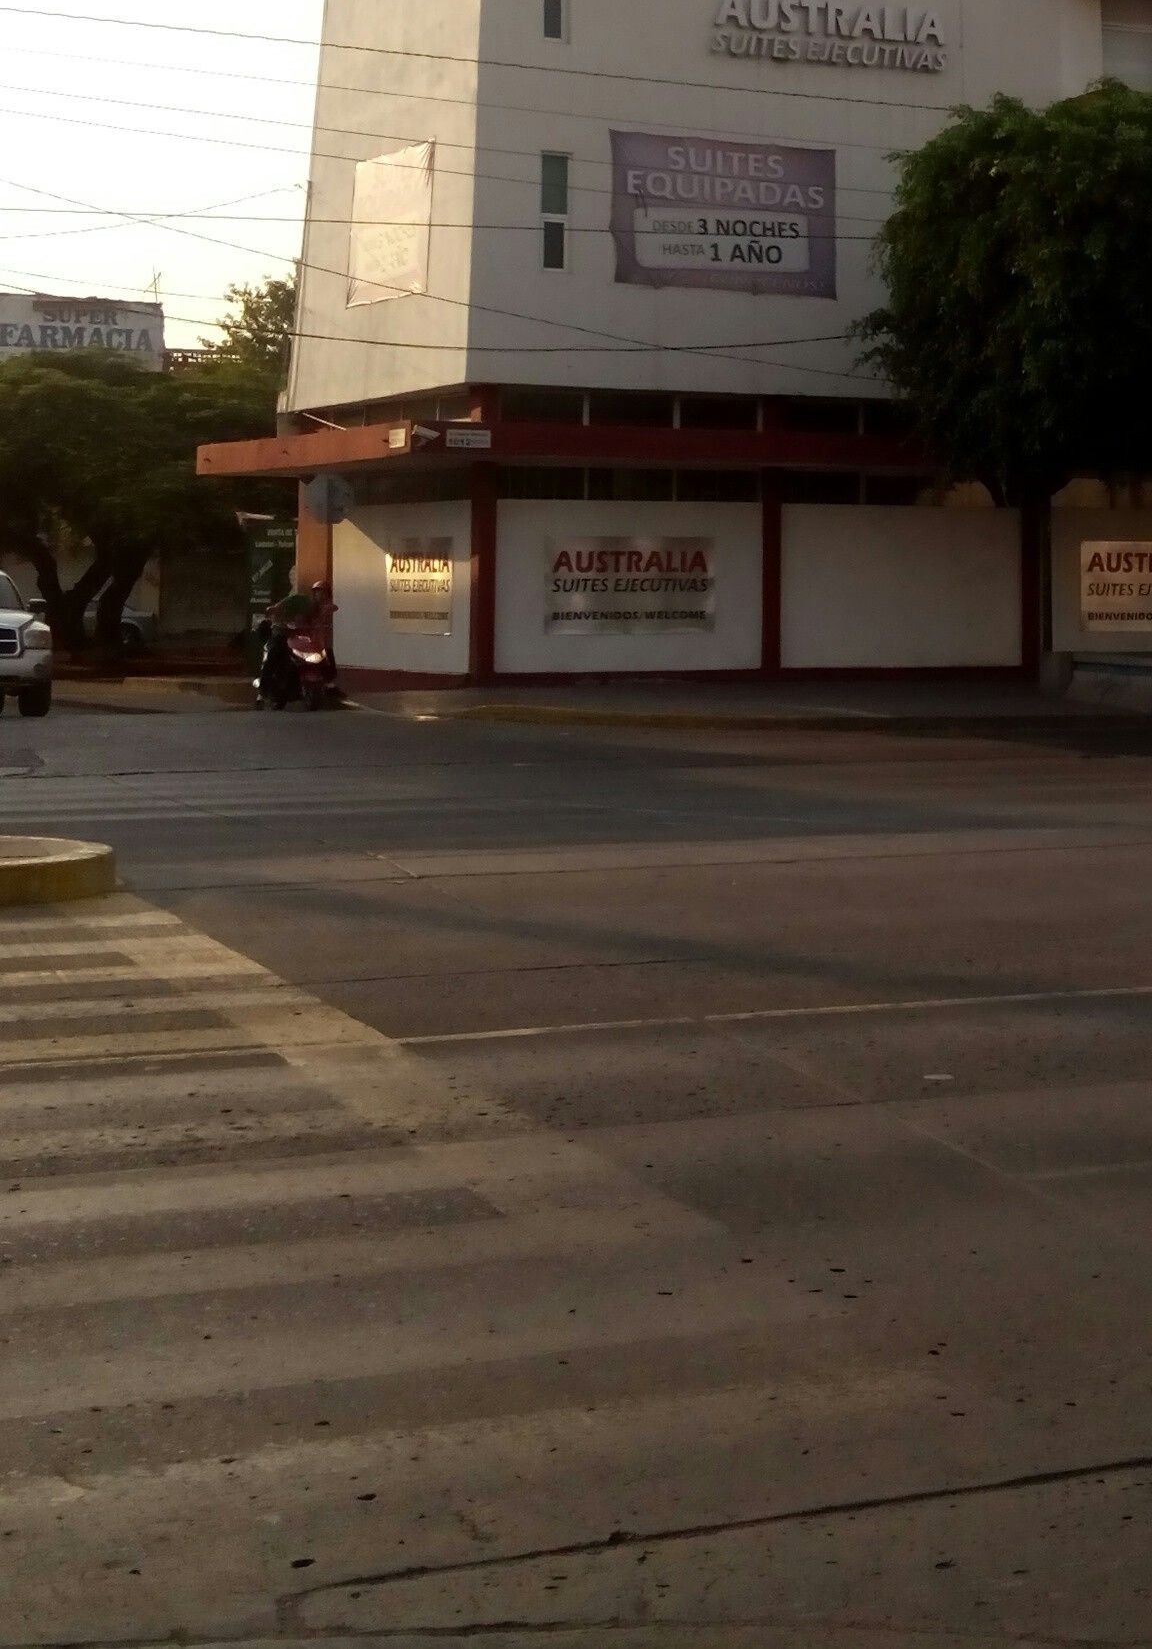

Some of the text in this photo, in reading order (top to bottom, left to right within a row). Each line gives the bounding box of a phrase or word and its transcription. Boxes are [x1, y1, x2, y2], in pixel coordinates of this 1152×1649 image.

[709, 34, 948, 72] SUITES EJECUTIVAS
[667, 146, 784, 179] SUITES
[627, 170, 824, 210] EQUIPADAS
[652, 219, 800, 239] DESDE 3 NOCHES
[662, 240, 782, 264] HASTA 1 AÑO
[43, 304, 118, 326] SUPER
[0, 324, 153, 352] FARMACIA
[390, 552, 450, 573] AUSTRALIA
[553, 550, 708, 573] AUSTRALIA
[552, 579, 709, 592] SUITES EJECUTIVAS
[1088, 583, 1133, 597] SUITES
